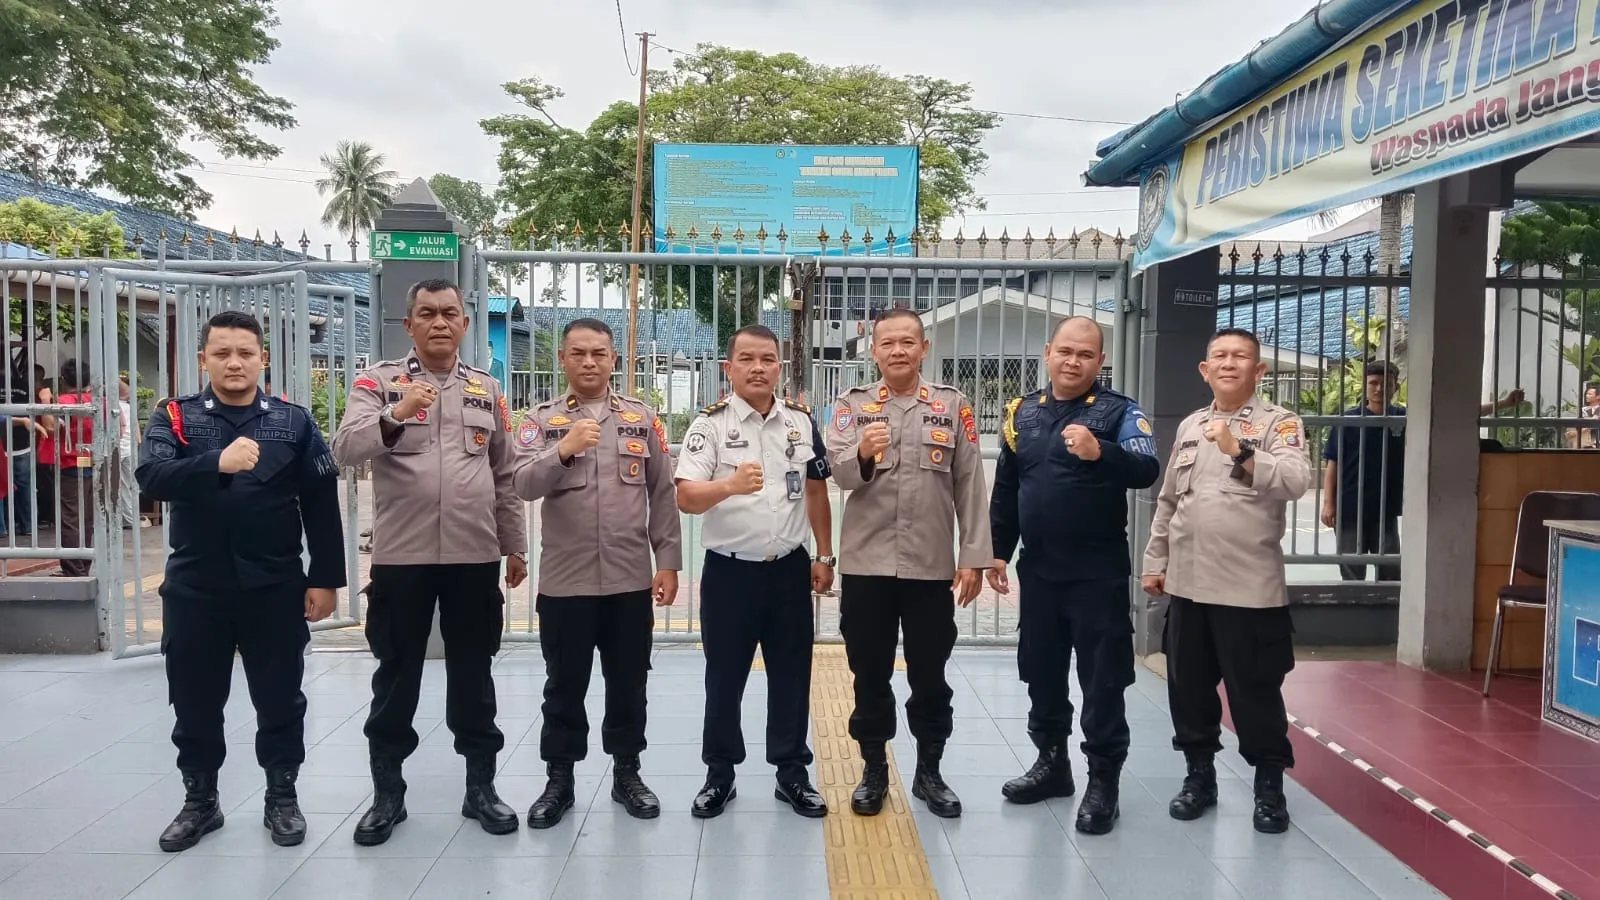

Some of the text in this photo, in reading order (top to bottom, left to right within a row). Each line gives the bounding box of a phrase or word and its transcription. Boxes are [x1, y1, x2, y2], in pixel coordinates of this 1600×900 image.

[1194, 0, 1579, 208] PERISTIWA SEKETIKA
[1370, 96, 1511, 174] Waspada
[417, 236, 446, 245] JALUR
[409, 246, 454, 256] EVAKUASI
[462, 397, 493, 412] POLRI
[922, 415, 953, 428] POLRI
[257, 430, 296, 441] IMIPAS
[616, 426, 648, 438] POLRI
